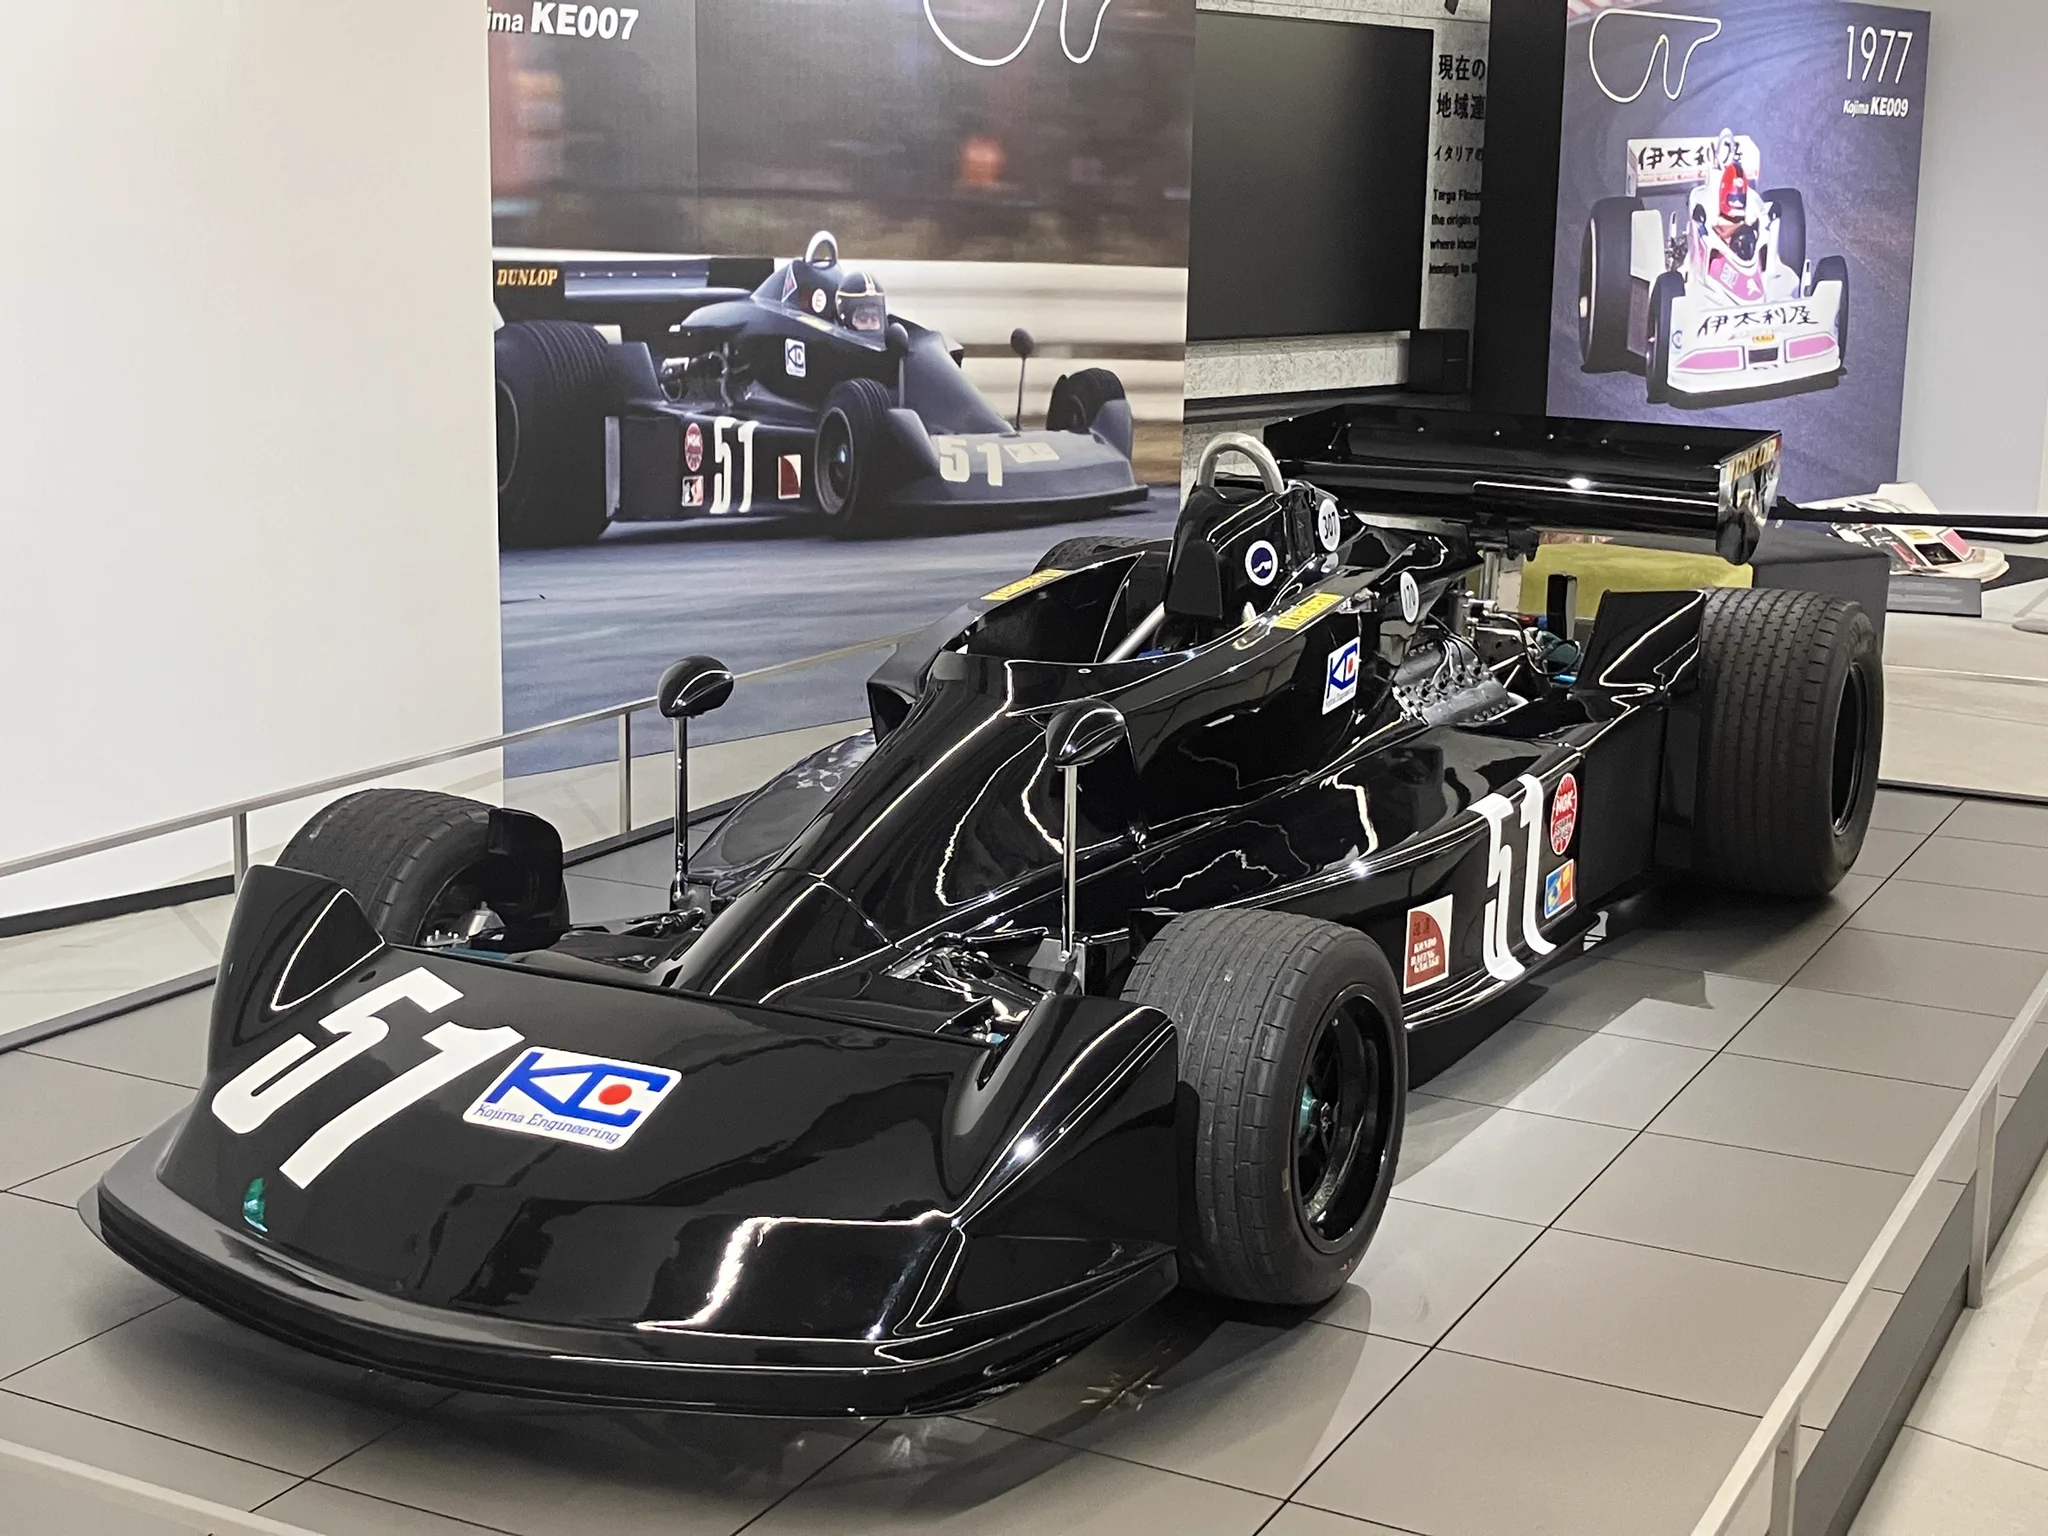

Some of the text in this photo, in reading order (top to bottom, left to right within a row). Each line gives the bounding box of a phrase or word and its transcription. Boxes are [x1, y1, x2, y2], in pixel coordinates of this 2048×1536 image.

[531, 1, 639, 40] KE007
[1439, 54, 1485, 80] 現在の
[1847, 25, 1913, 84] 1977
[1843, 96, 1909, 117] Kojima KE009
[1433, 188, 1481, 204] Targa Flori
[1432, 214, 1445, 226] the
[1446, 214, 1471, 228] origin
[496, 268, 558, 286] DUNLOP
[1697, 305, 1819, 337] 伊太利屋
[709, 415, 760, 514] 51
[938, 436, 1003, 486] 51
[1466, 773, 1557, 981] 51
[212, 966, 525, 1189] 51
[472, 1103, 621, 1144] Kojima Engineering
